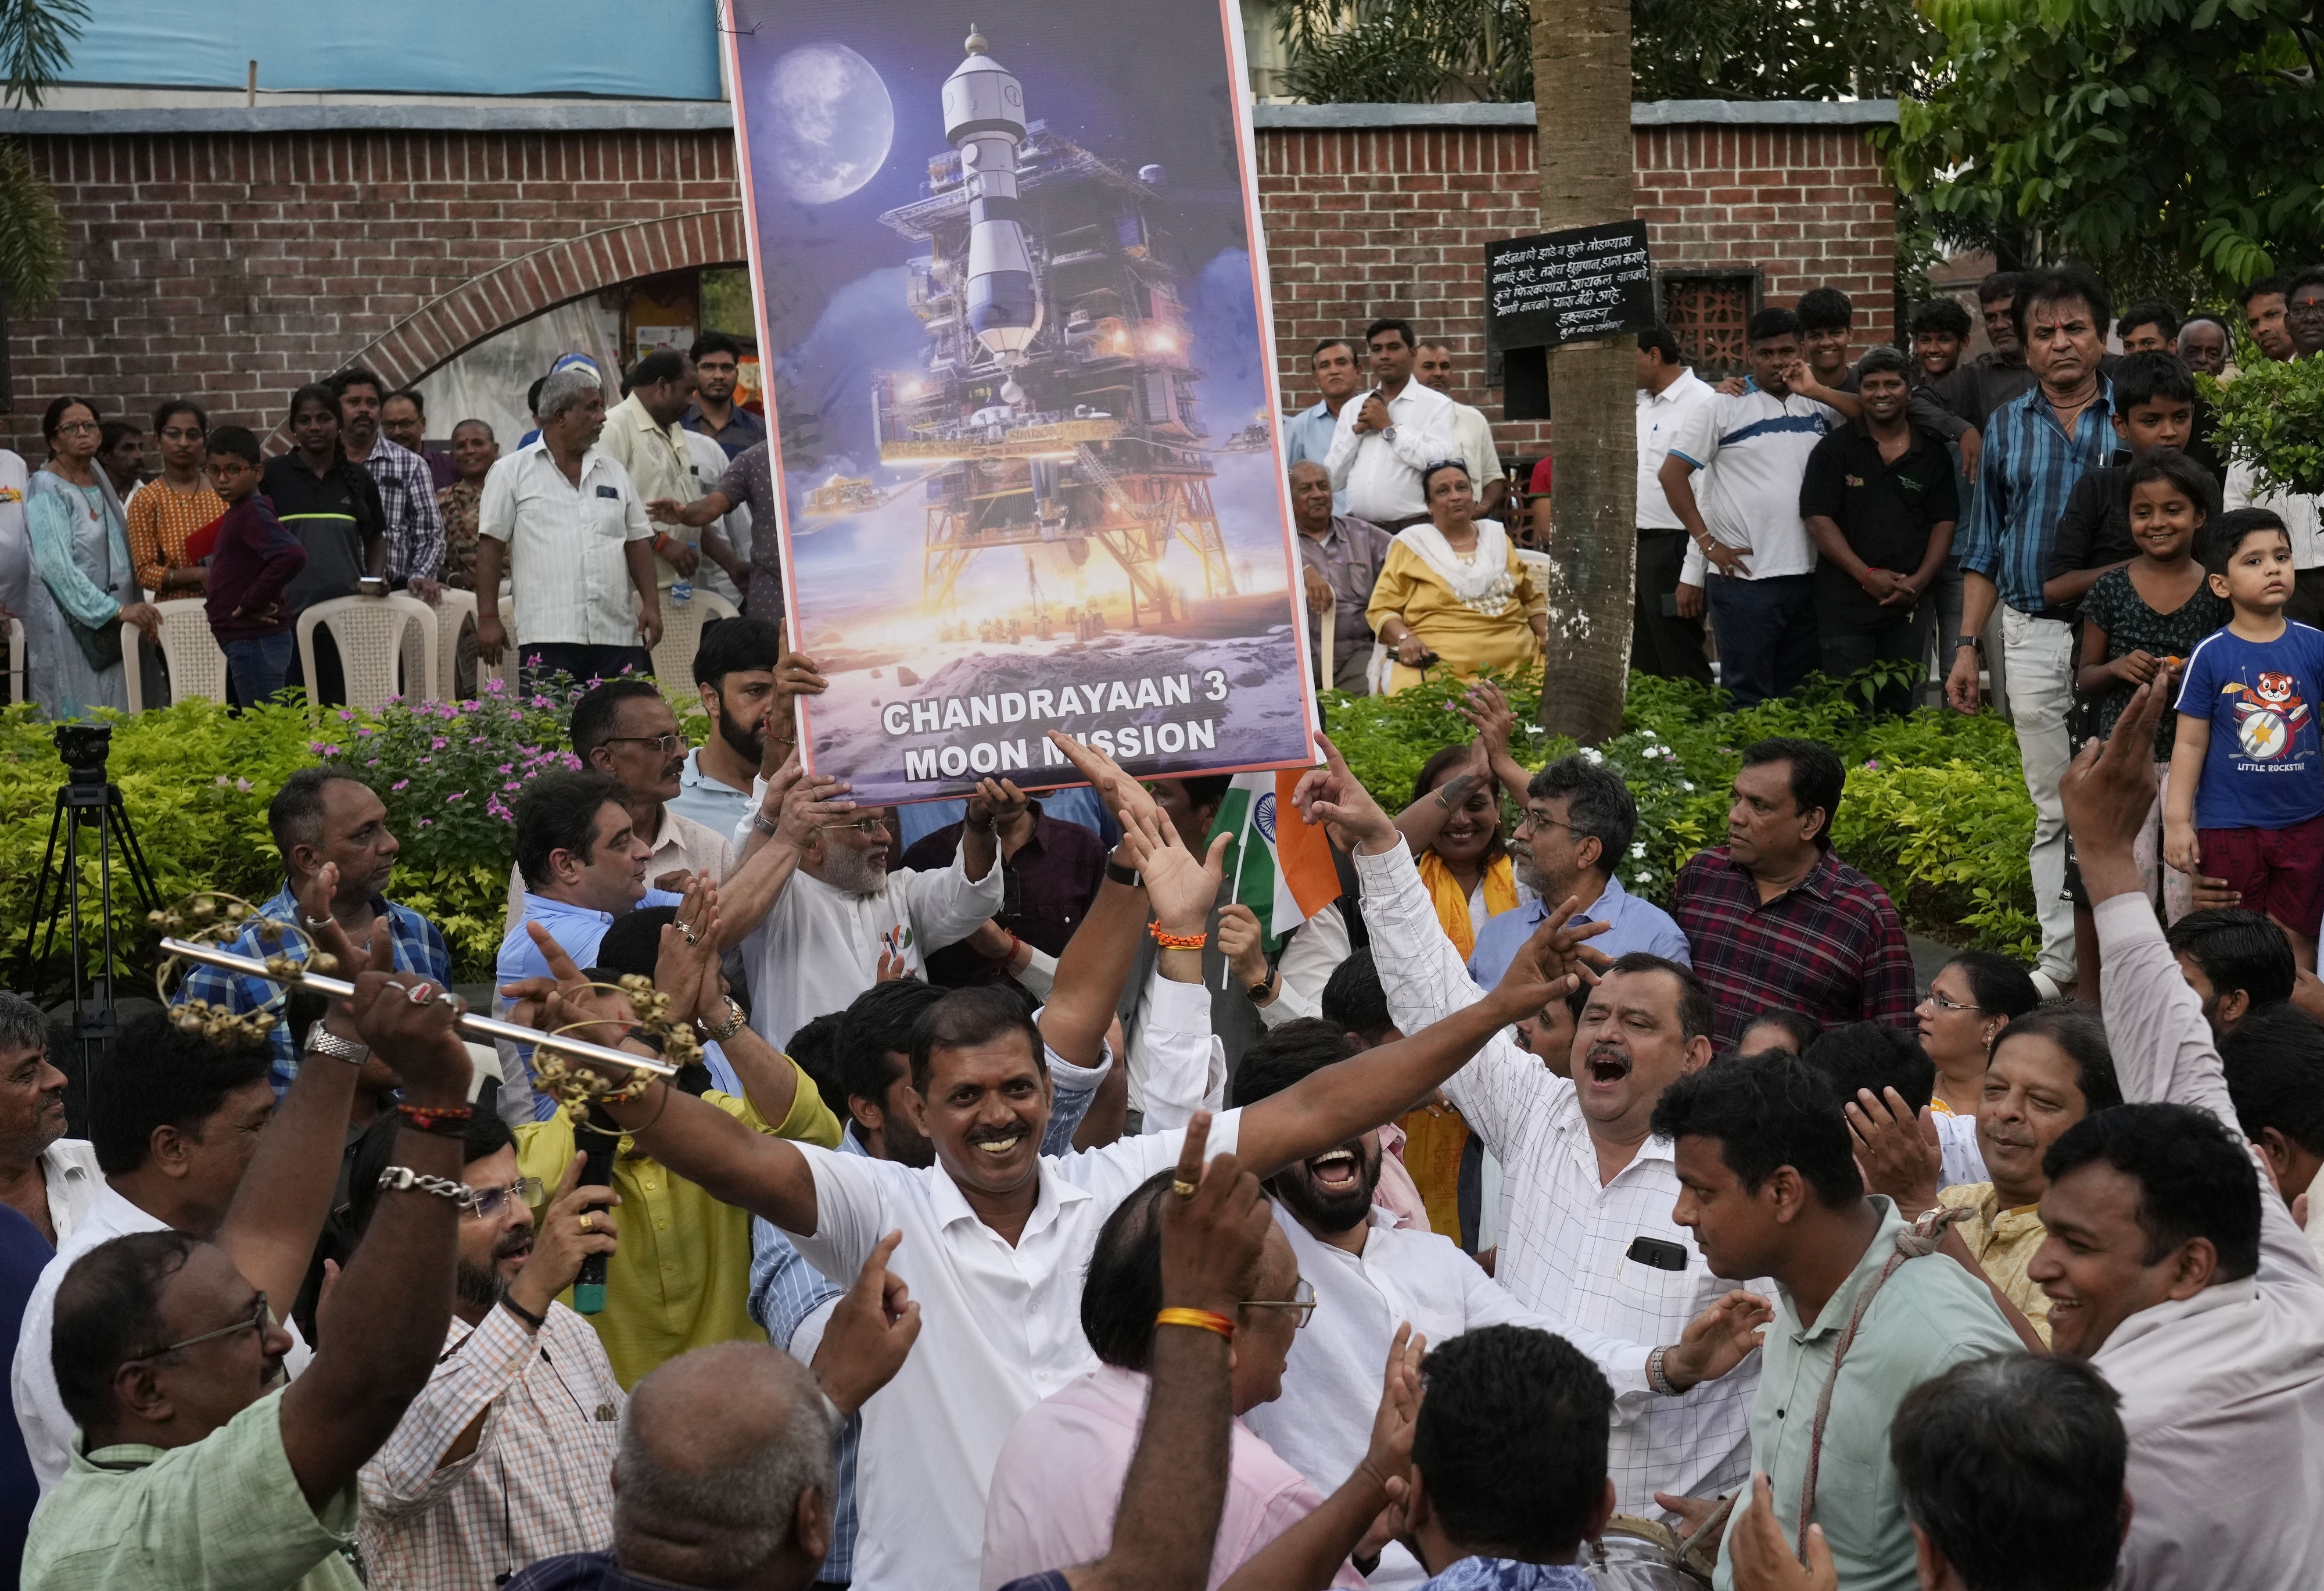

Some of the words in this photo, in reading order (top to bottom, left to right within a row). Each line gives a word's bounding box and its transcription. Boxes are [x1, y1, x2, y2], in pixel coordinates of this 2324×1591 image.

[1537, 243, 1556, 260] झाडे
[1557, 245, 1565, 255] व
[1566, 239, 1586, 259] फुले
[1587, 235, 1634, 250] तोडण्यास
[1493, 266, 1516, 284] मनाई
[1540, 261, 1566, 278] तसेच
[1493, 286, 1512, 308] कुत्रे
[1570, 274, 1613, 290] सायकल
[1496, 300, 1520, 317] गाणी
[1519, 295, 1552, 312] वाजवणे
[1552, 295, 1577, 307] यास
[1575, 289, 1596, 306] बंदी
[1596, 286, 1626, 304] आहे.
[883, 673, 1191, 736] CHANDRAYAAN
[1204, 670, 1228, 701] 3
[905, 739, 1028, 781] MOON
[2237, 762, 2265, 772] LITTLE
[2268, 762, 2305, 772] ROCKSTAR
